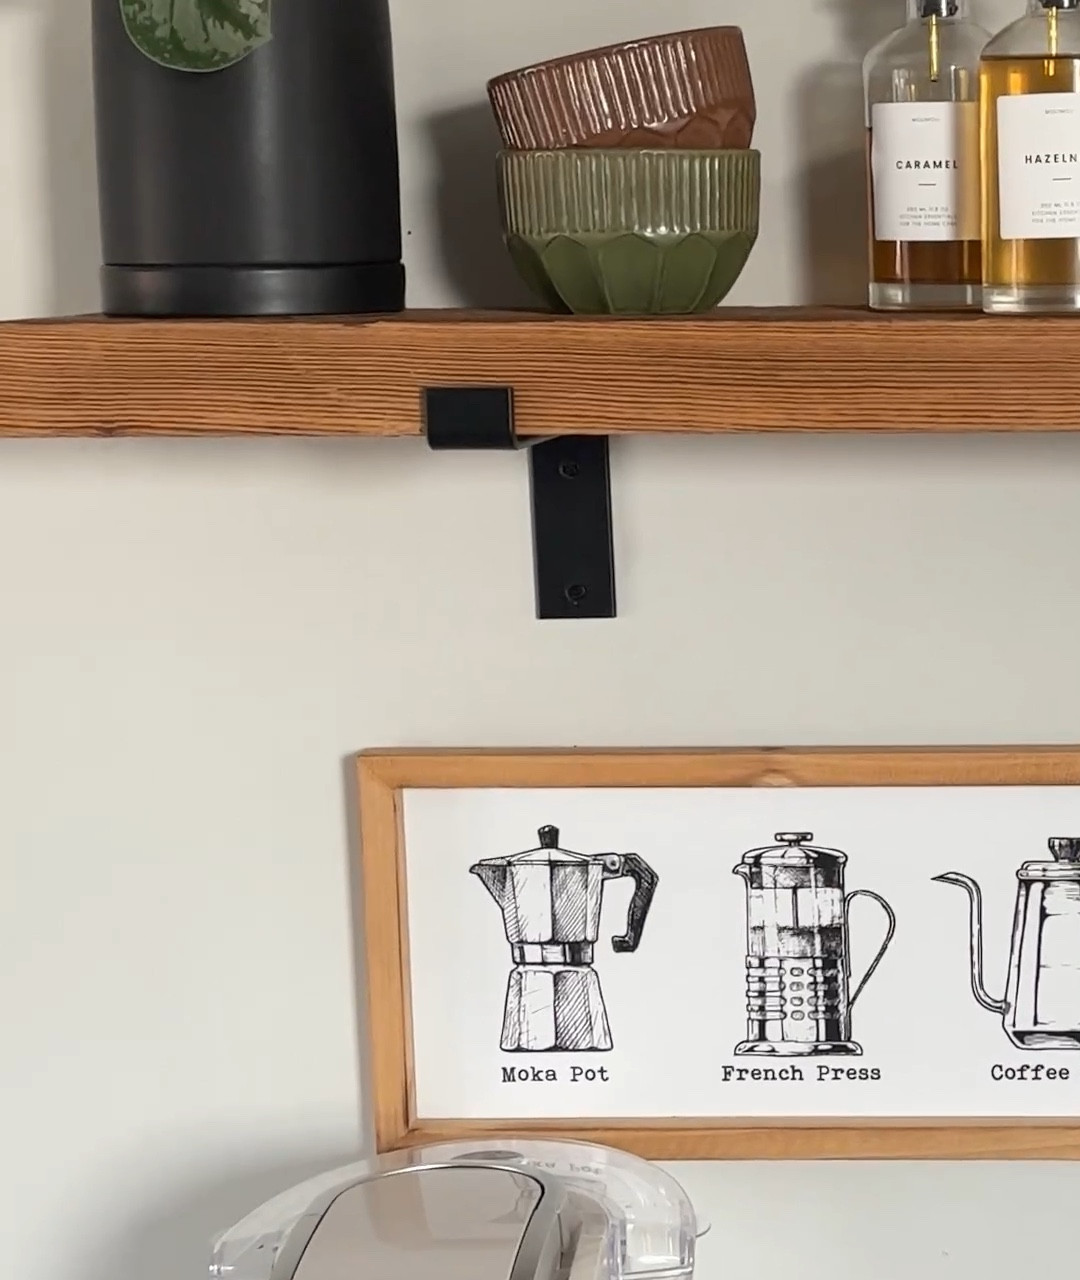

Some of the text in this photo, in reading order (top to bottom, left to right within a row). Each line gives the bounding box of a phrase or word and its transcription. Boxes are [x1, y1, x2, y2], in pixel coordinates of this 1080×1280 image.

[895, 160, 959, 169] CARAMEL
[501, 1065, 610, 1083] Moka Pot
[721, 1065, 881, 1081] French Press
[991, 1064, 1070, 1081] Coffee
